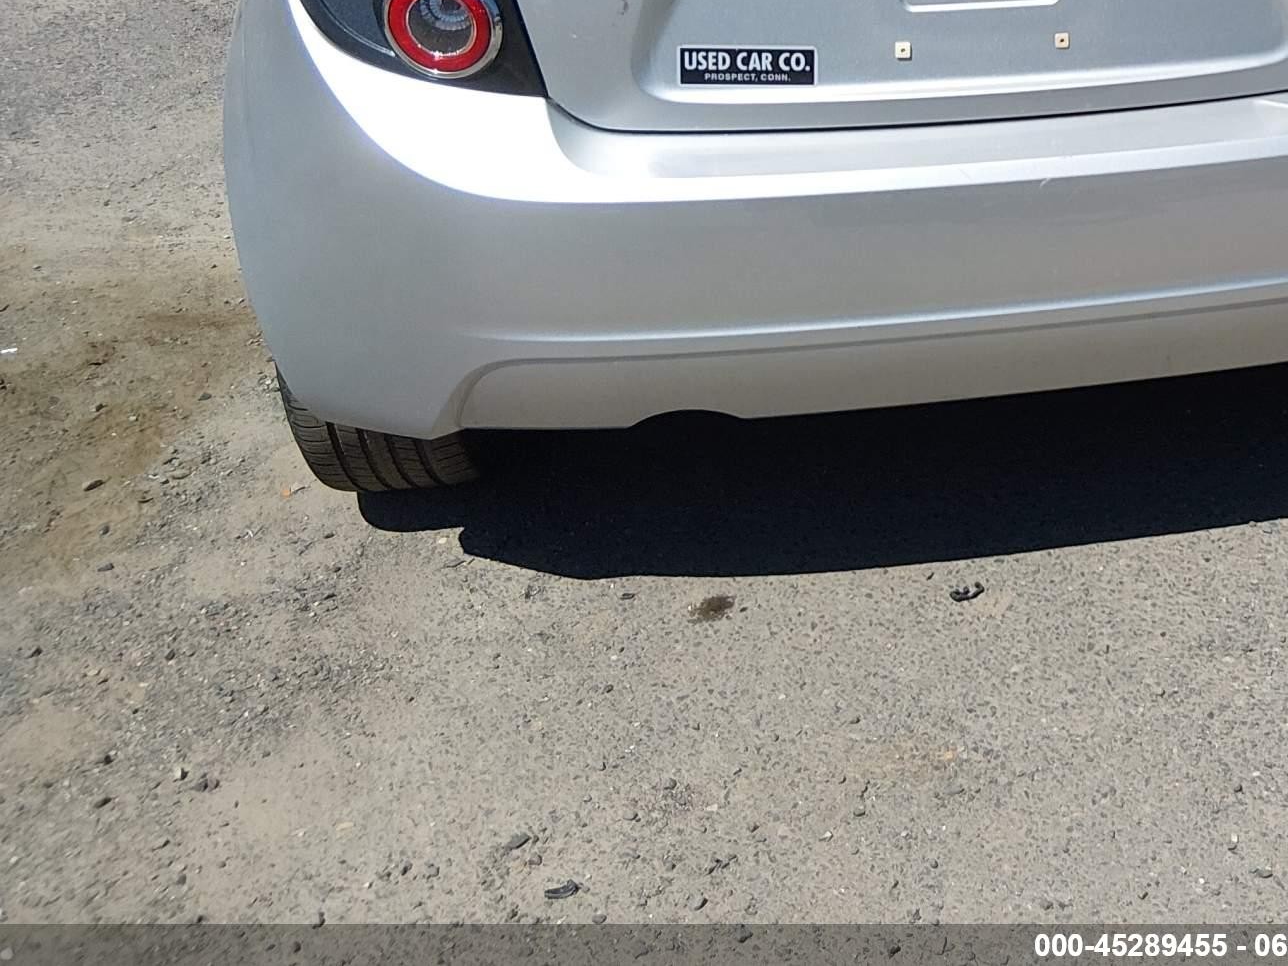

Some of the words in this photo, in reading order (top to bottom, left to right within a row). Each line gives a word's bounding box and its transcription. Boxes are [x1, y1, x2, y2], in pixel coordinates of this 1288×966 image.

[684, 51, 731, 71] USED
[736, 51, 773, 71] CAR
[778, 52, 811, 72] CO.
[704, 72, 759, 83] PROSPECT,
[760, 73, 791, 83] CONN.
